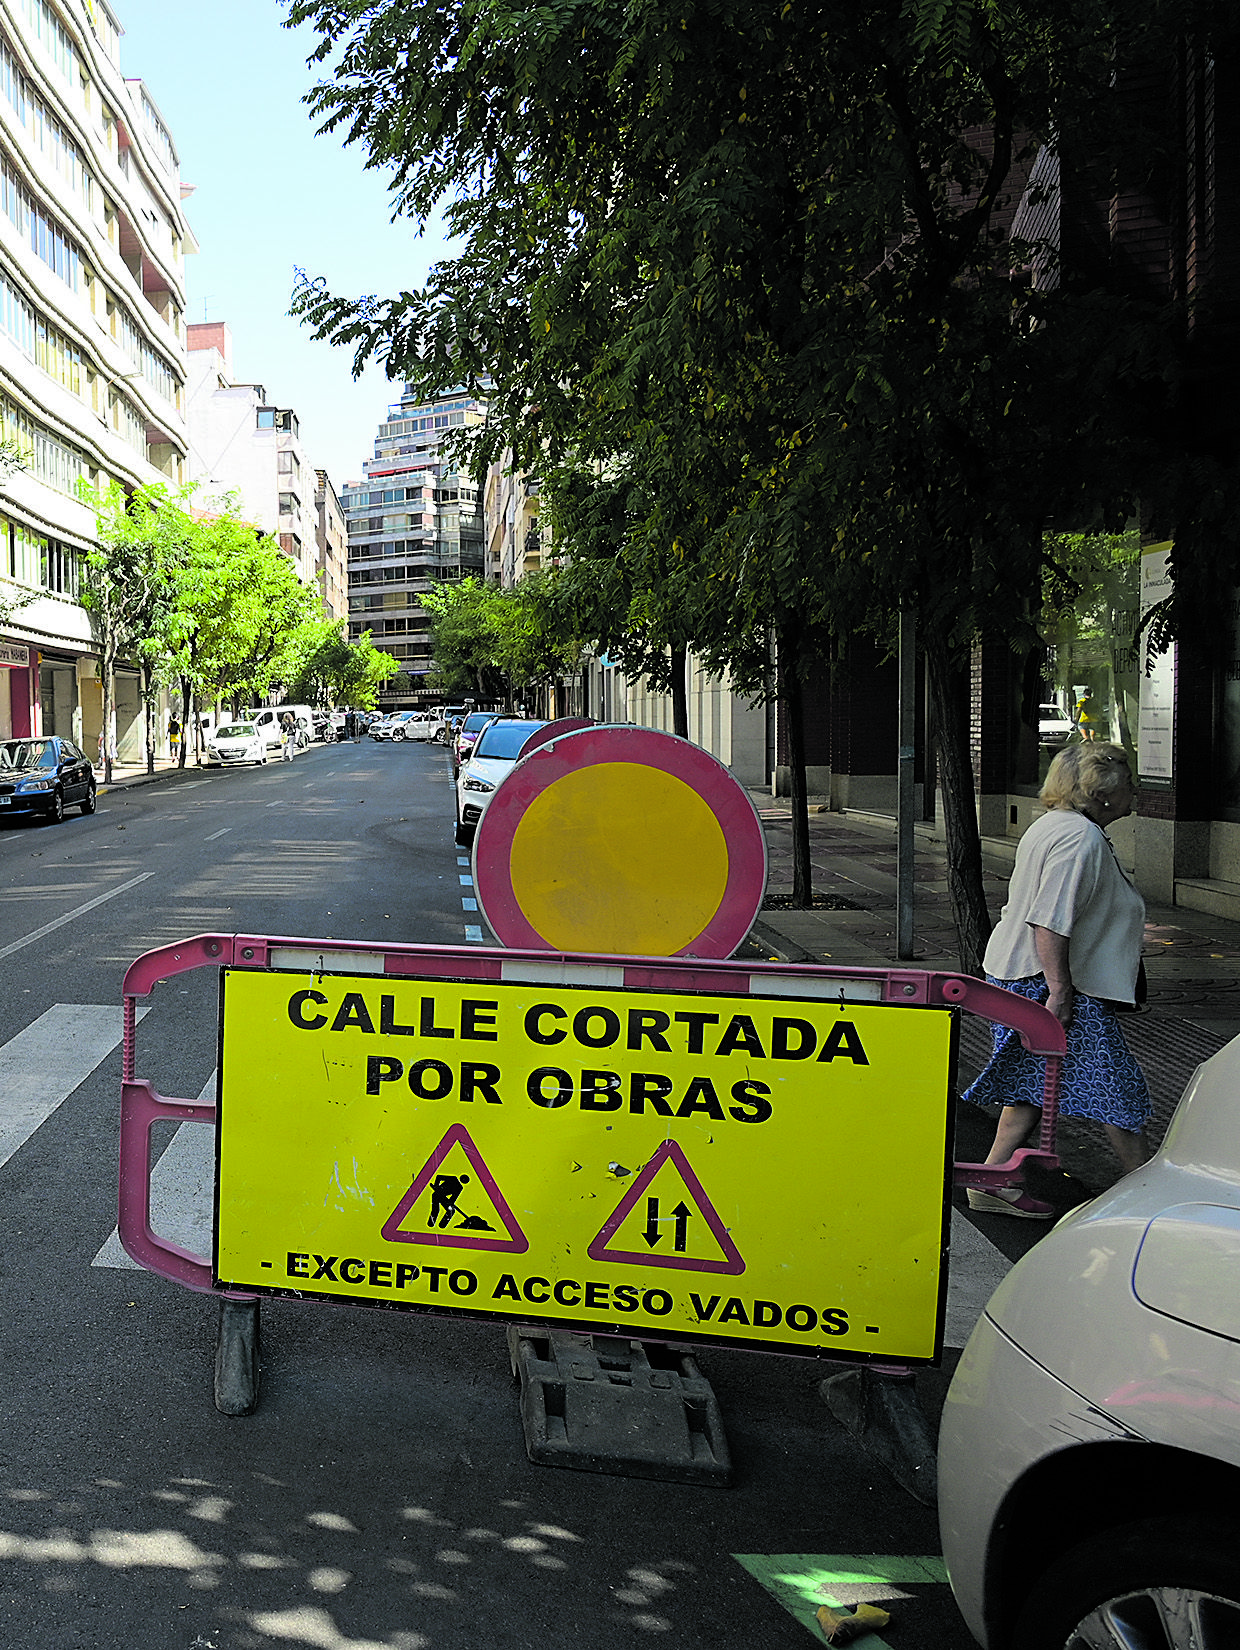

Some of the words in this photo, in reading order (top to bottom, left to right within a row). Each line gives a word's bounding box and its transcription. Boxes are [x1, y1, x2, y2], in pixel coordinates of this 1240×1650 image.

[287, 989, 499, 1042] CALLE
[524, 1003, 870, 1066] CORTADA
[365, 1055, 504, 1105] POR
[526, 1066, 773, 1124] OBRAS
[286, 1251, 478, 1296] EXCEPTO
[491, 1273, 674, 1316] ACCESO
[689, 1293, 850, 1336] VADOS
